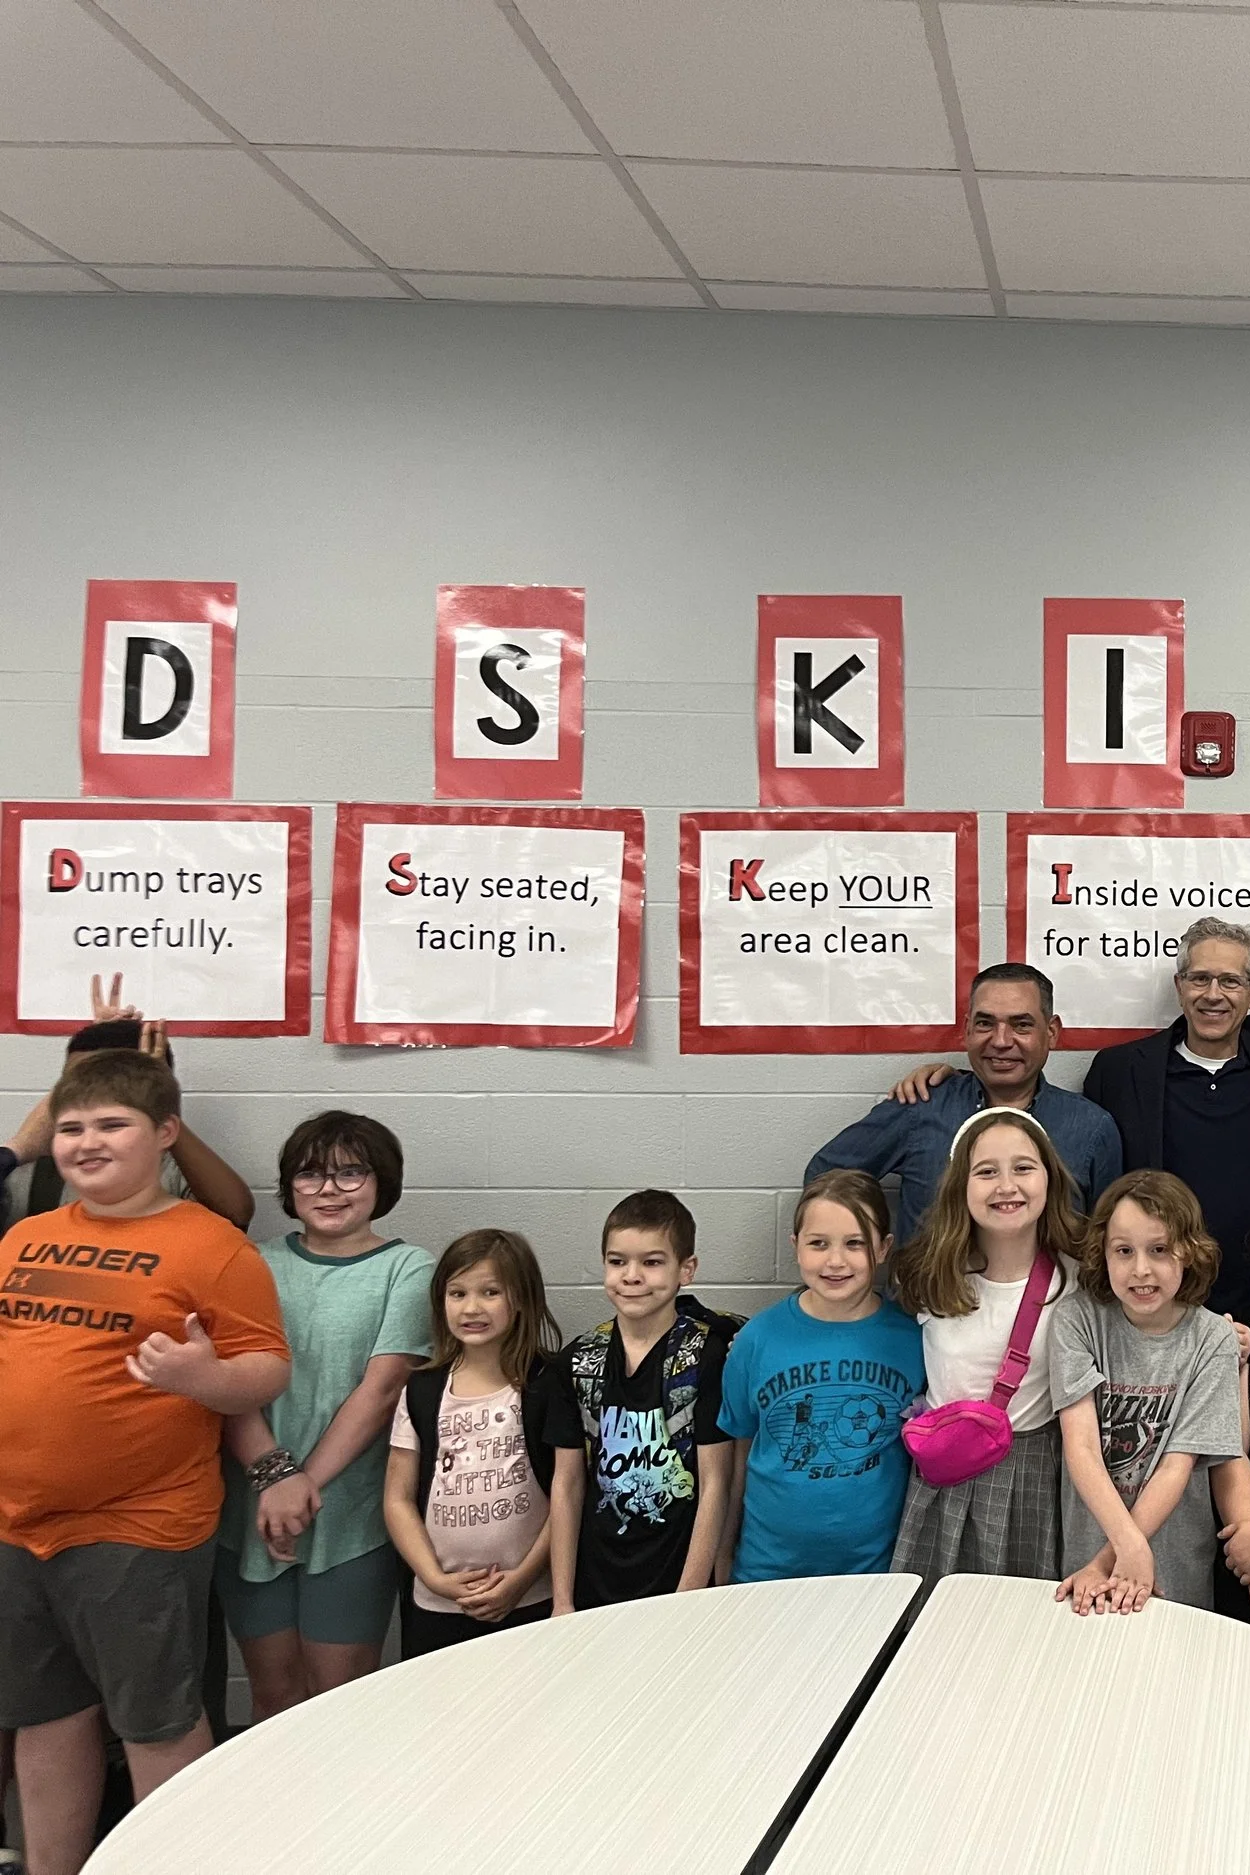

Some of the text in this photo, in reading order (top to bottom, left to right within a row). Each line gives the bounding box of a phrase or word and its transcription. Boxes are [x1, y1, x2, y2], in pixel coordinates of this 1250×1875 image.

[122, 637, 194, 740] D
[476, 643, 540, 745] S
[793, 651, 865, 755] K
[1105, 648, 1124, 749] I
[48, 848, 263, 901] Dump trays
[385, 852, 599, 907] Stay seated,
[728, 858, 934, 909] Keep YOUR
[1051, 862, 1159, 907] Inside
[74, 917, 233, 955] carefully.
[416, 921, 567, 958] facing in.
[740, 926, 920, 954] area clean.
[1044, 928, 1090, 957] for
[17, 1243, 161, 1276] UNDER
[0, 1298, 137, 1333] ARMOUR
[757, 1360, 914, 1410] STARKE COUNTY
[476, 1434, 527, 1460] THE
[443, 1461, 527, 1496] LITTLE
[432, 1492, 530, 1527] THINGS
